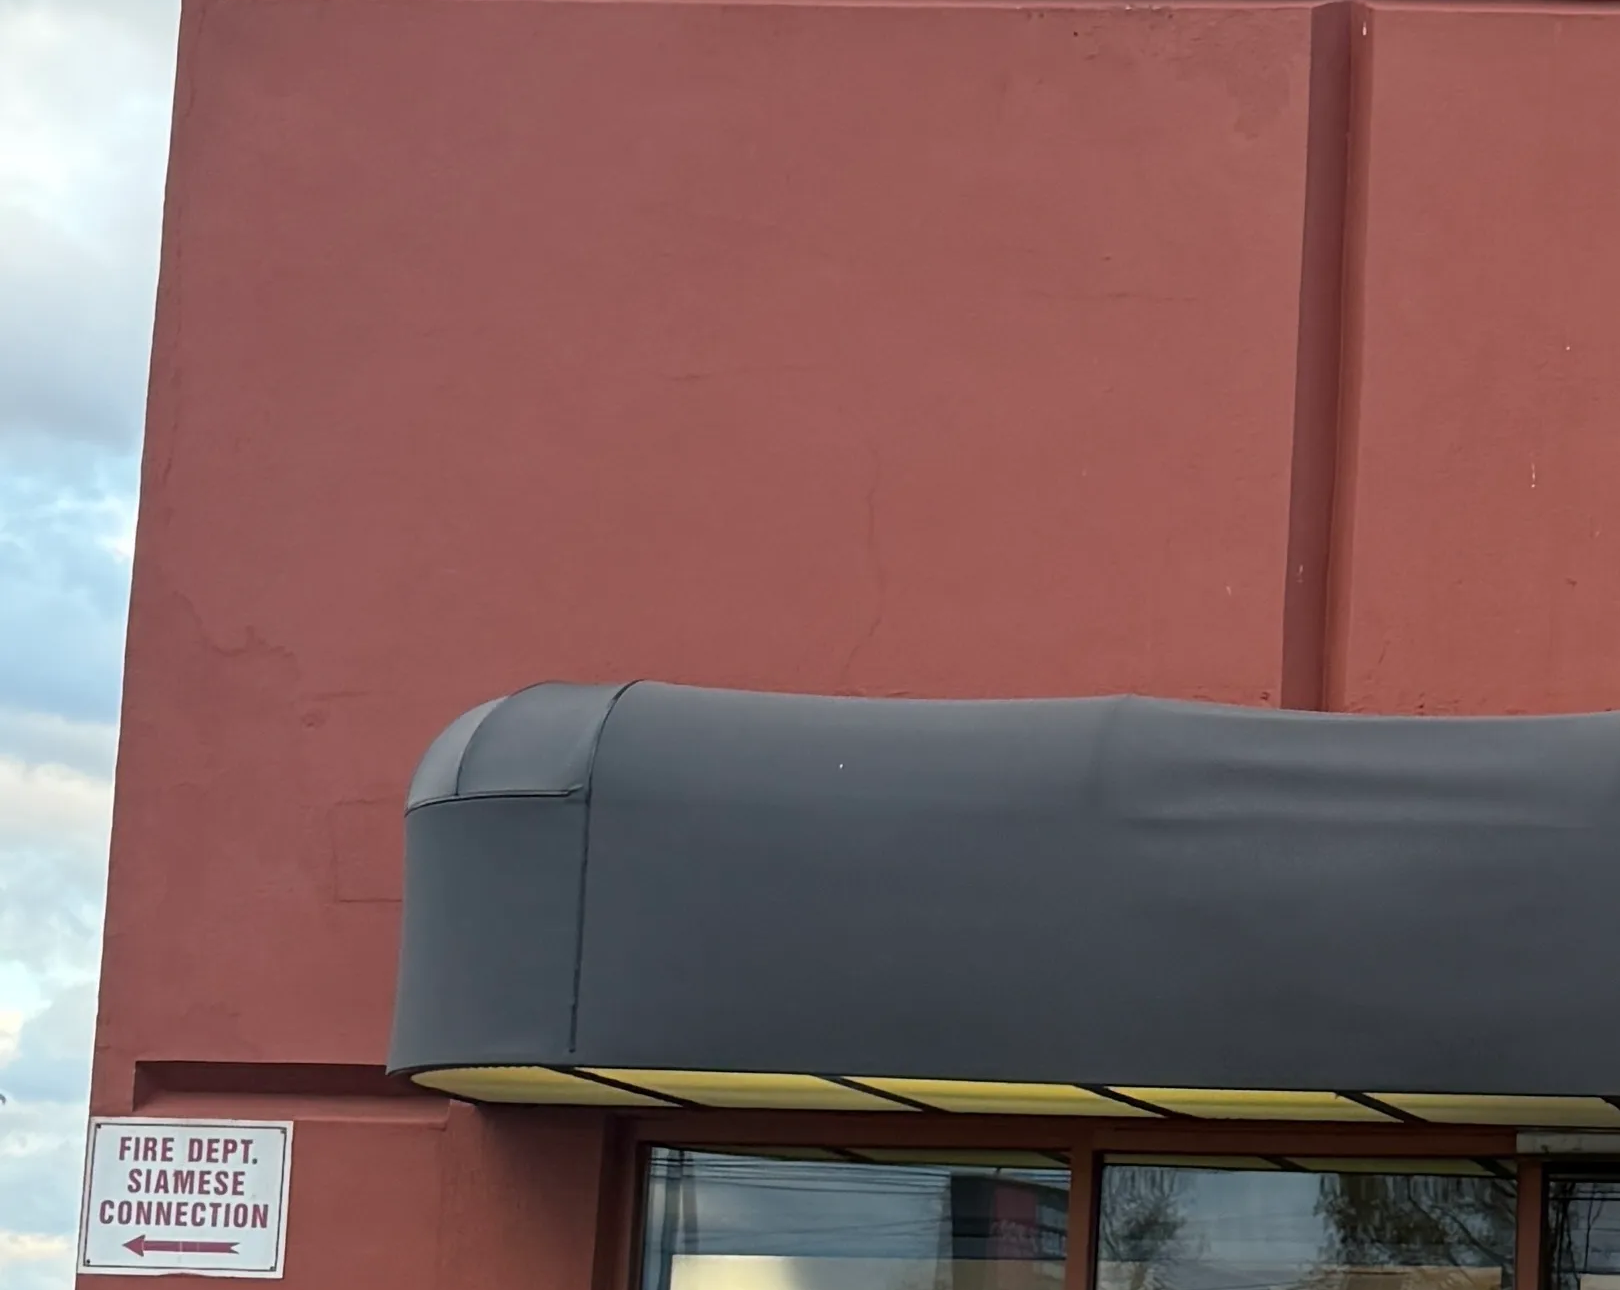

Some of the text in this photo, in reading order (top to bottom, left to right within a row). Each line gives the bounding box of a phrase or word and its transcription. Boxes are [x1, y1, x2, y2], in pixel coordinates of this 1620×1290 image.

[118, 1136, 260, 1165] FIRE DEPT.
[127, 1168, 246, 1197] SIAMESE
[99, 1199, 269, 1229] CONNECTION
